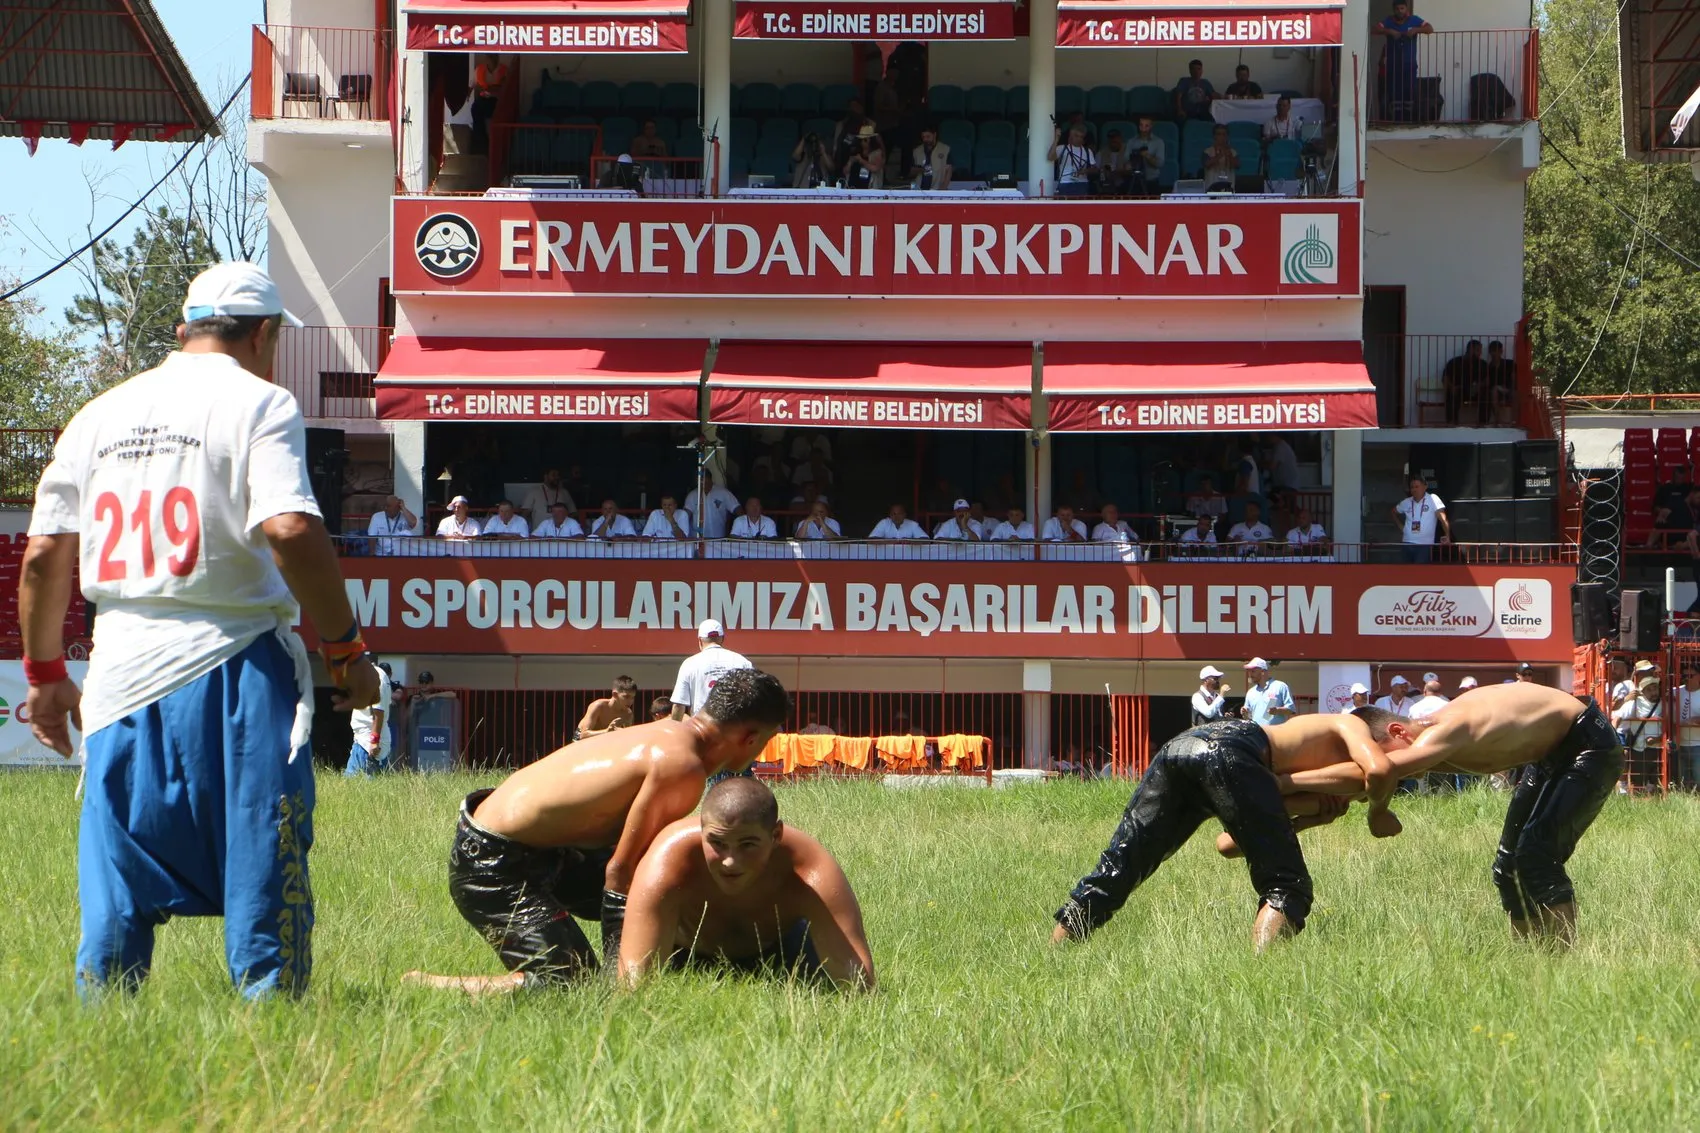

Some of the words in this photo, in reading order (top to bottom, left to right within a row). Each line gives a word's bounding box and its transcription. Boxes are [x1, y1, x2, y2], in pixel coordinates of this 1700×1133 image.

[434, 25, 468, 45] T.C.
[474, 21, 544, 46] EDİRNE
[550, 22, 658, 46] BELEDİYESİ
[763, 13, 796, 33] T.C.
[802, 9, 871, 34] EDİRNE
[876, 9, 985, 34] BELEDİYESİ
[1086, 20, 1119, 41] T.C.
[1125, 16, 1195, 41] EDİRNE
[1200, 15, 1311, 40] BELEDİYESİ
[499, 219, 875, 277] ERMEYDANI
[894, 223, 1248, 276] KIRKPINAR
[425, 394, 459, 415] T.C.
[465, 390, 535, 415] EDİRNE
[540, 391, 649, 416] BELEDİYESİ
[760, 399, 793, 419] T.C.
[799, 395, 868, 421] EDİRNE
[873, 398, 983, 422] BELEDİYESİ
[1098, 405, 1132, 425] T.C.
[1137, 401, 1208, 425] EDİRNE
[1214, 398, 1326, 425] BELEDİYESİ
[94, 486, 200, 583] 219
[401, 578, 834, 631] SPORCULARIMIZA
[845, 582, 1116, 637] BAŞARILAR
[1392, 602, 1411, 612] Av.
[1408, 589, 1458, 619] Filiz
[1374, 614, 1436, 626] GENCAN
[1441, 615, 1477, 626] AKIN
[1500, 614, 1542, 626] Edirne
